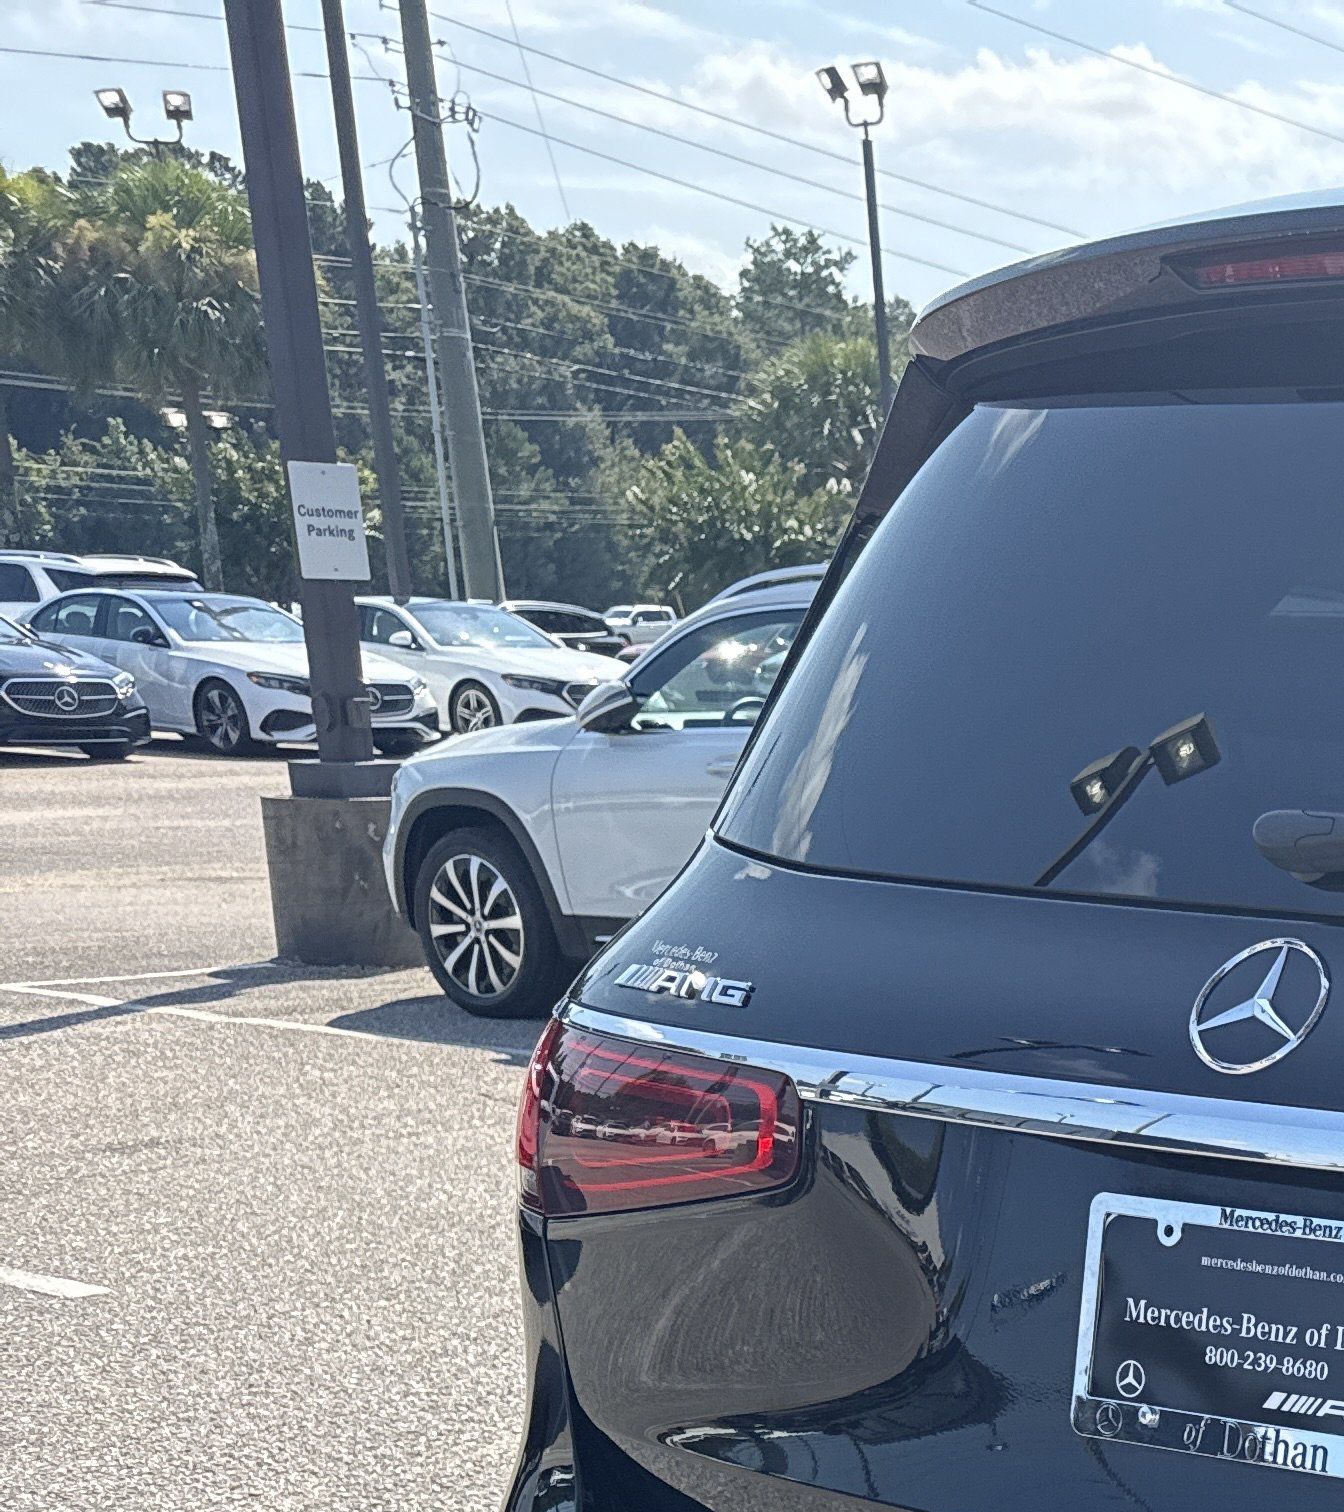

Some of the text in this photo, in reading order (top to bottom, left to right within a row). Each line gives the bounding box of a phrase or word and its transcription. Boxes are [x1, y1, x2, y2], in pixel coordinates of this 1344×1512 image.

[297, 504, 360, 520] Customer
[306, 523, 356, 541] Parking
[649, 966, 753, 1007] AMG
[1218, 1207, 1344, 1241] Mercedes-Benz
[1124, 1297, 1299, 1346] Mercedes-Benz
[1304, 1323, 1332, 1348] of
[1204, 1345, 1330, 1382] 800-239-8680
[1182, 1416, 1330, 1474] of Dothan
